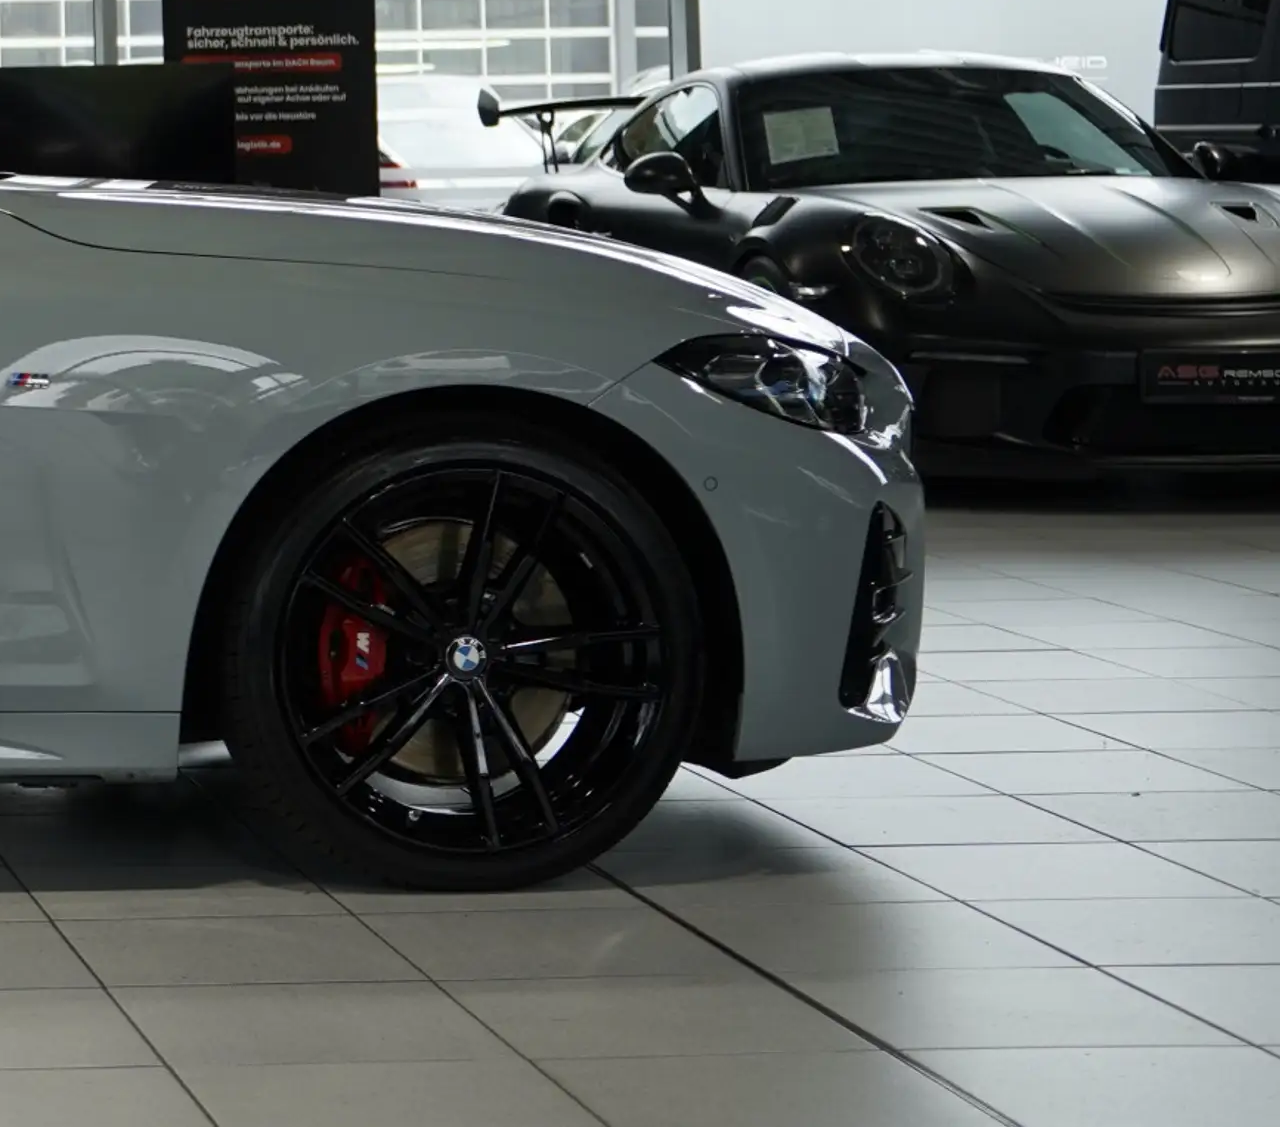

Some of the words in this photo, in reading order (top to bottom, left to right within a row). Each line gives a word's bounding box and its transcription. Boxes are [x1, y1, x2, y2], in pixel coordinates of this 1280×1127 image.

[187, 25, 314, 39] Fahrzeugtransporte:
[187, 37, 228, 50] sicher,
[231, 36, 276, 48] schnell
[278, 37, 287, 47] &
[290, 33, 360, 50] persönlich.
